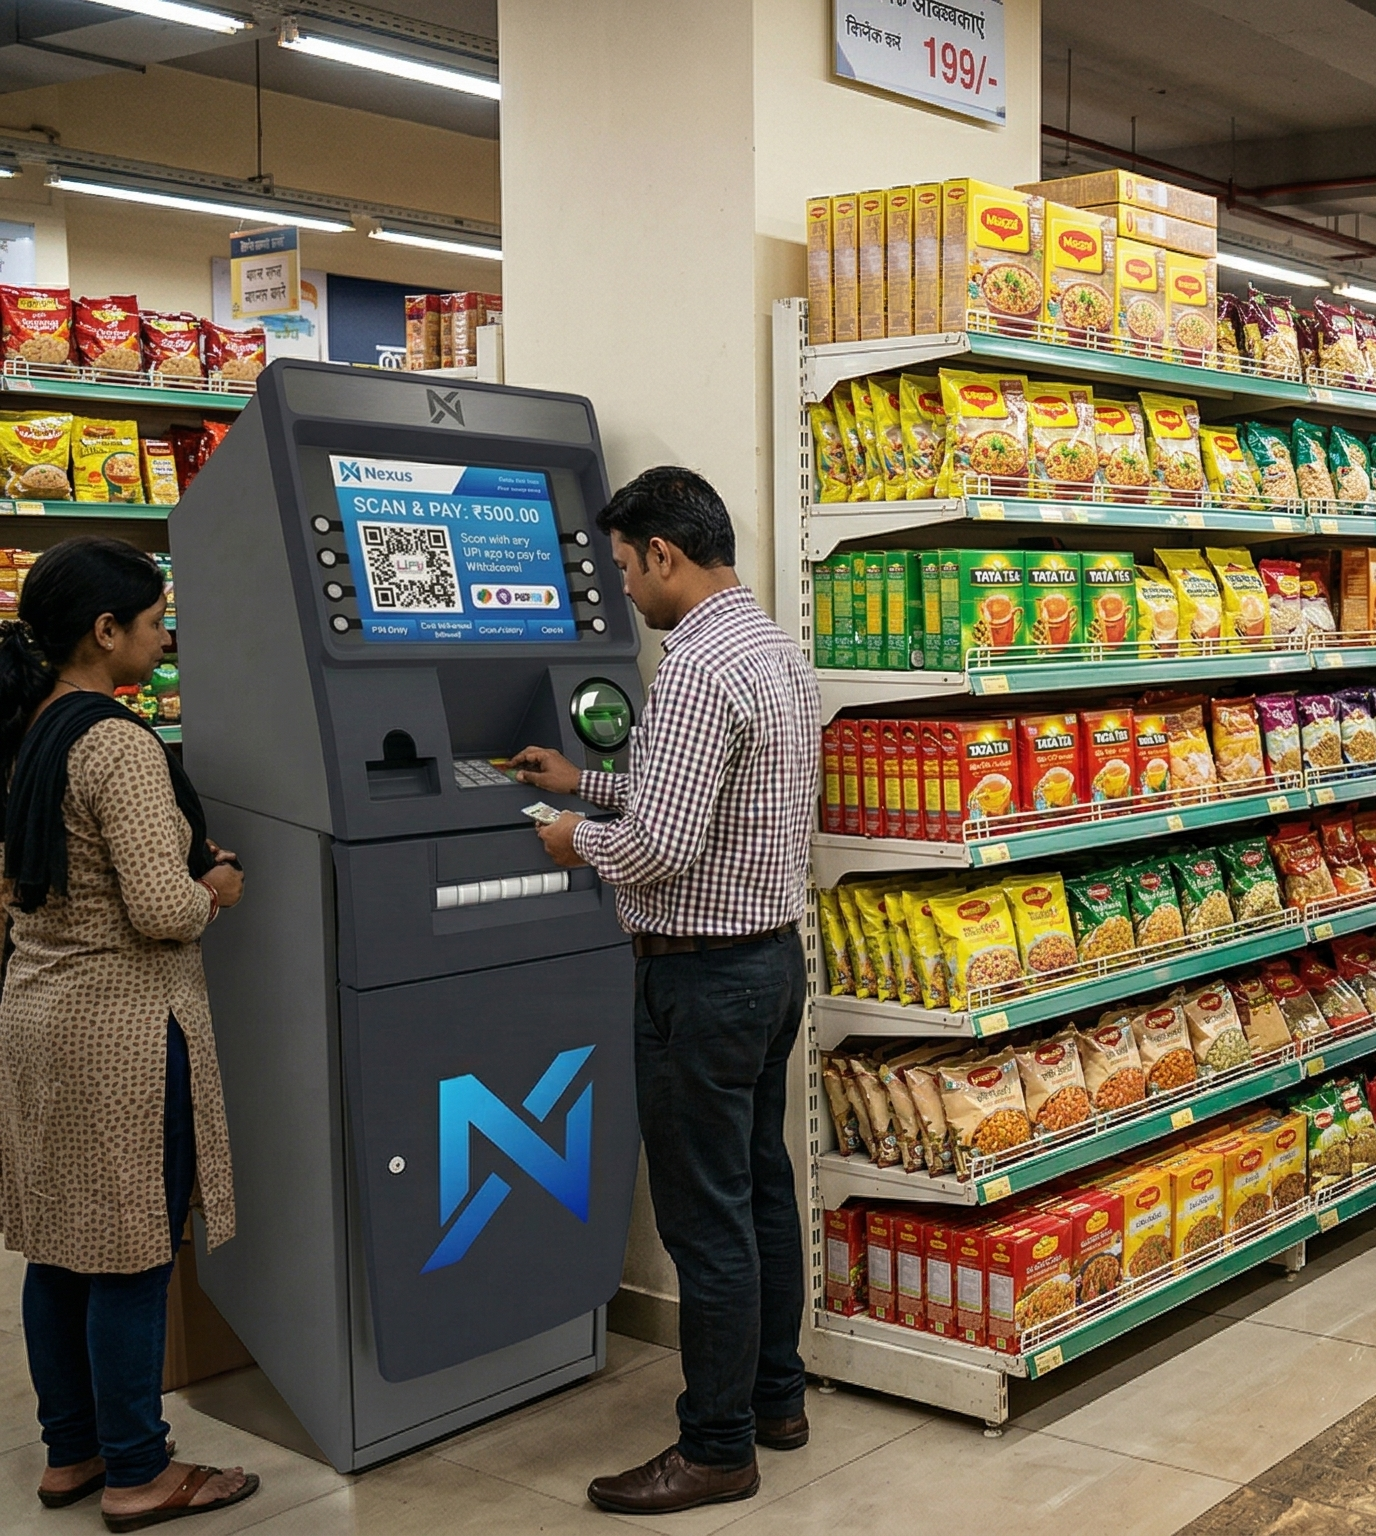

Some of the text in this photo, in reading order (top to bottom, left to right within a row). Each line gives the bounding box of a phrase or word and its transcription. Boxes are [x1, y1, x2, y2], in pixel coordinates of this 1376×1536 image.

[924, 37, 997, 95] 199/-
[365, 467, 413, 483] Nexus
[353, 497, 540, 524] SCAN & PAY: ₹500.00
[504, 550, 515, 559] to
[536, 550, 551, 560] for
[975, 571, 1002, 582] TATA
[1032, 571, 1059, 582] TATA
[1089, 571, 1113, 582] TATA
